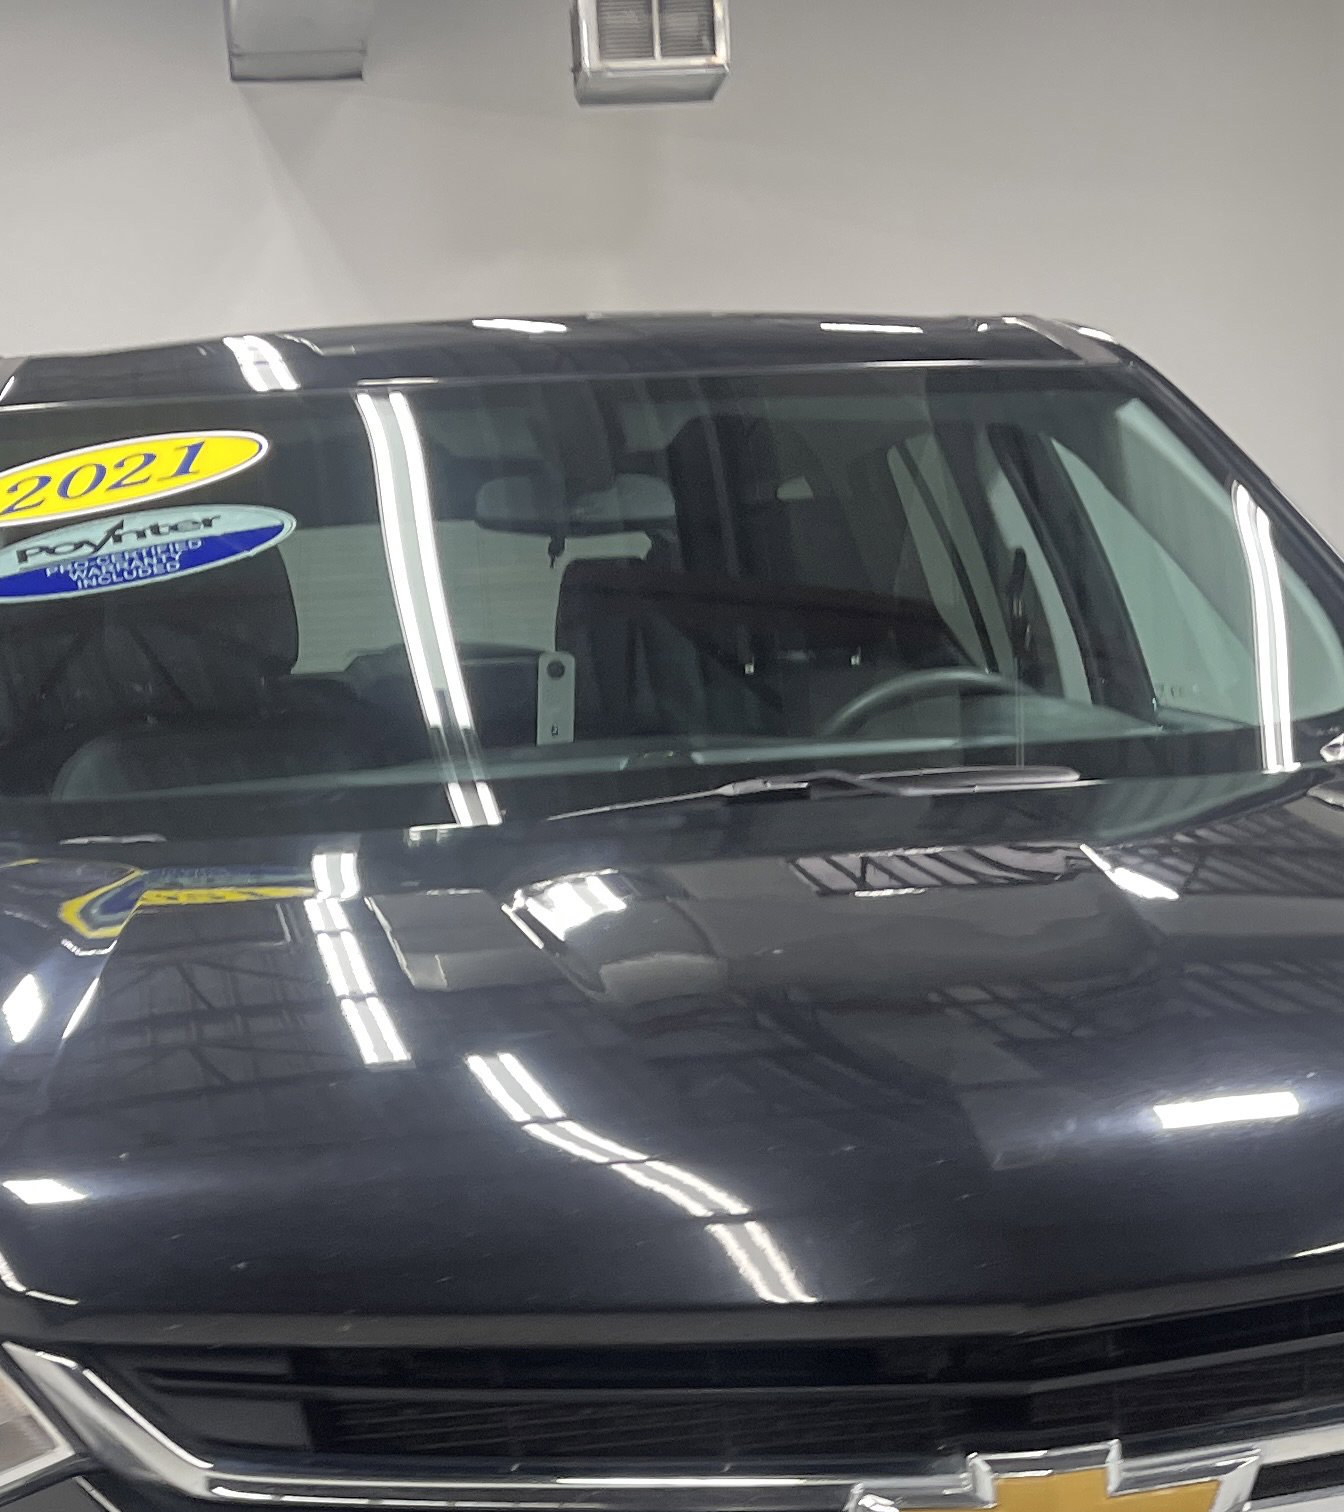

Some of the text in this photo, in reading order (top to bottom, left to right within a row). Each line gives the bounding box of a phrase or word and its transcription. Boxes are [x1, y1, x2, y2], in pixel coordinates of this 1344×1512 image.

[15, 515, 222, 564] Poynter
[69, 551, 183, 582] WARRANTY
[76, 562, 181, 590] INCLUDED
